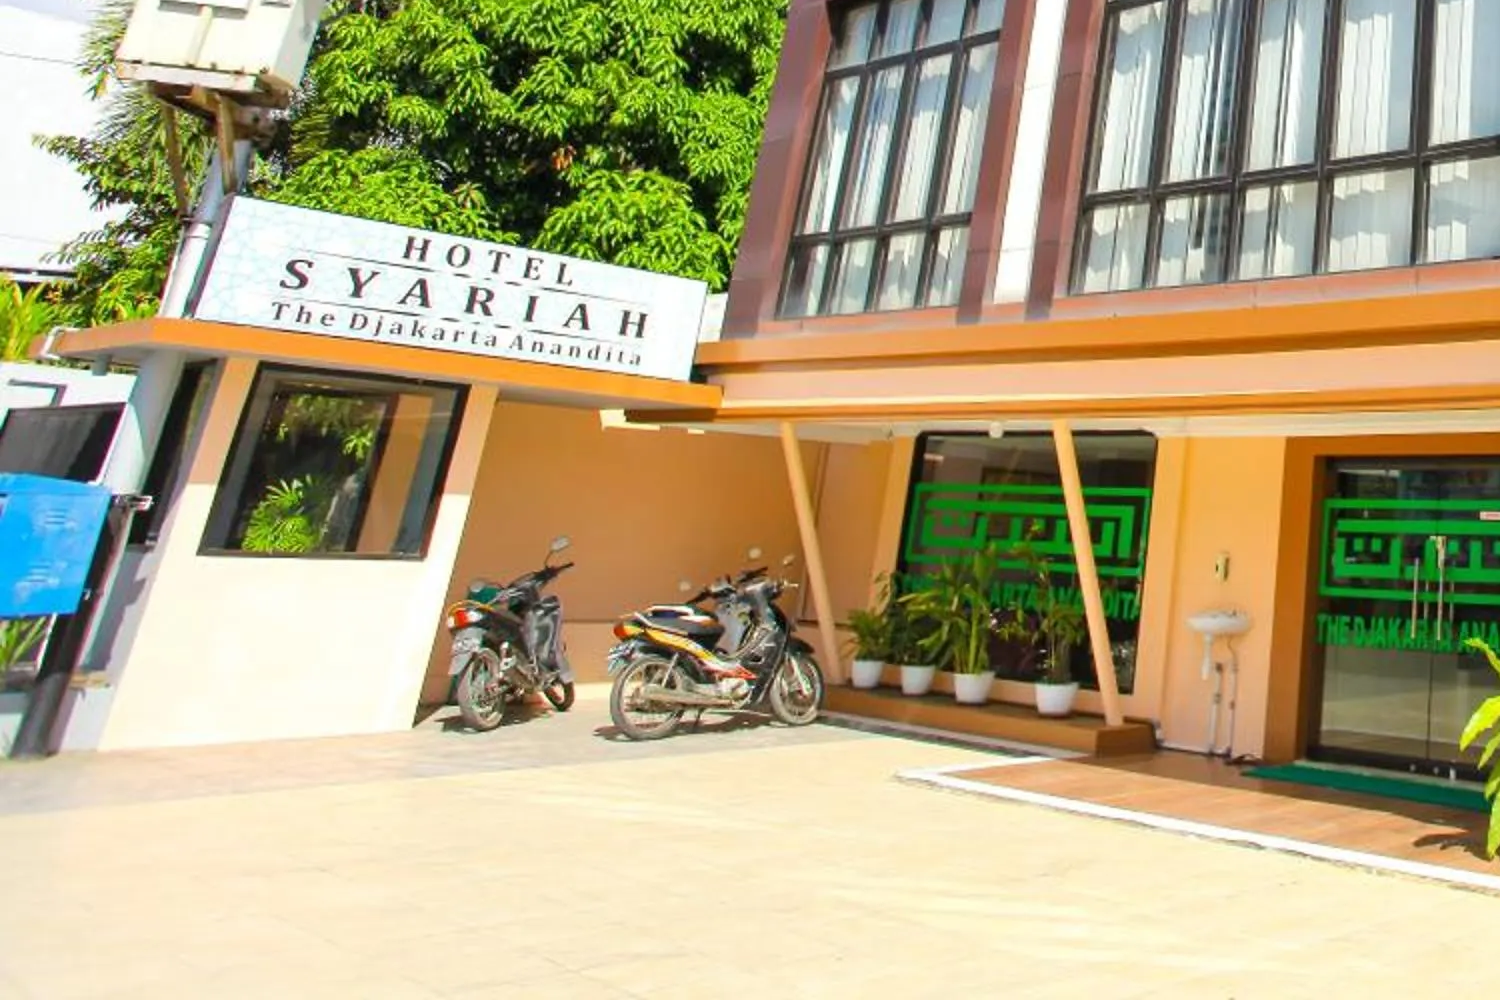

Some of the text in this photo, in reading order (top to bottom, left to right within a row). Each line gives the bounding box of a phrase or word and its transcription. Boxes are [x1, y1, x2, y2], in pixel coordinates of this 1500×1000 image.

[402, 235, 574, 287] HOTEL
[279, 258, 649, 339] SYARIAH
[271, 301, 642, 367] The Djakarta Anandita
